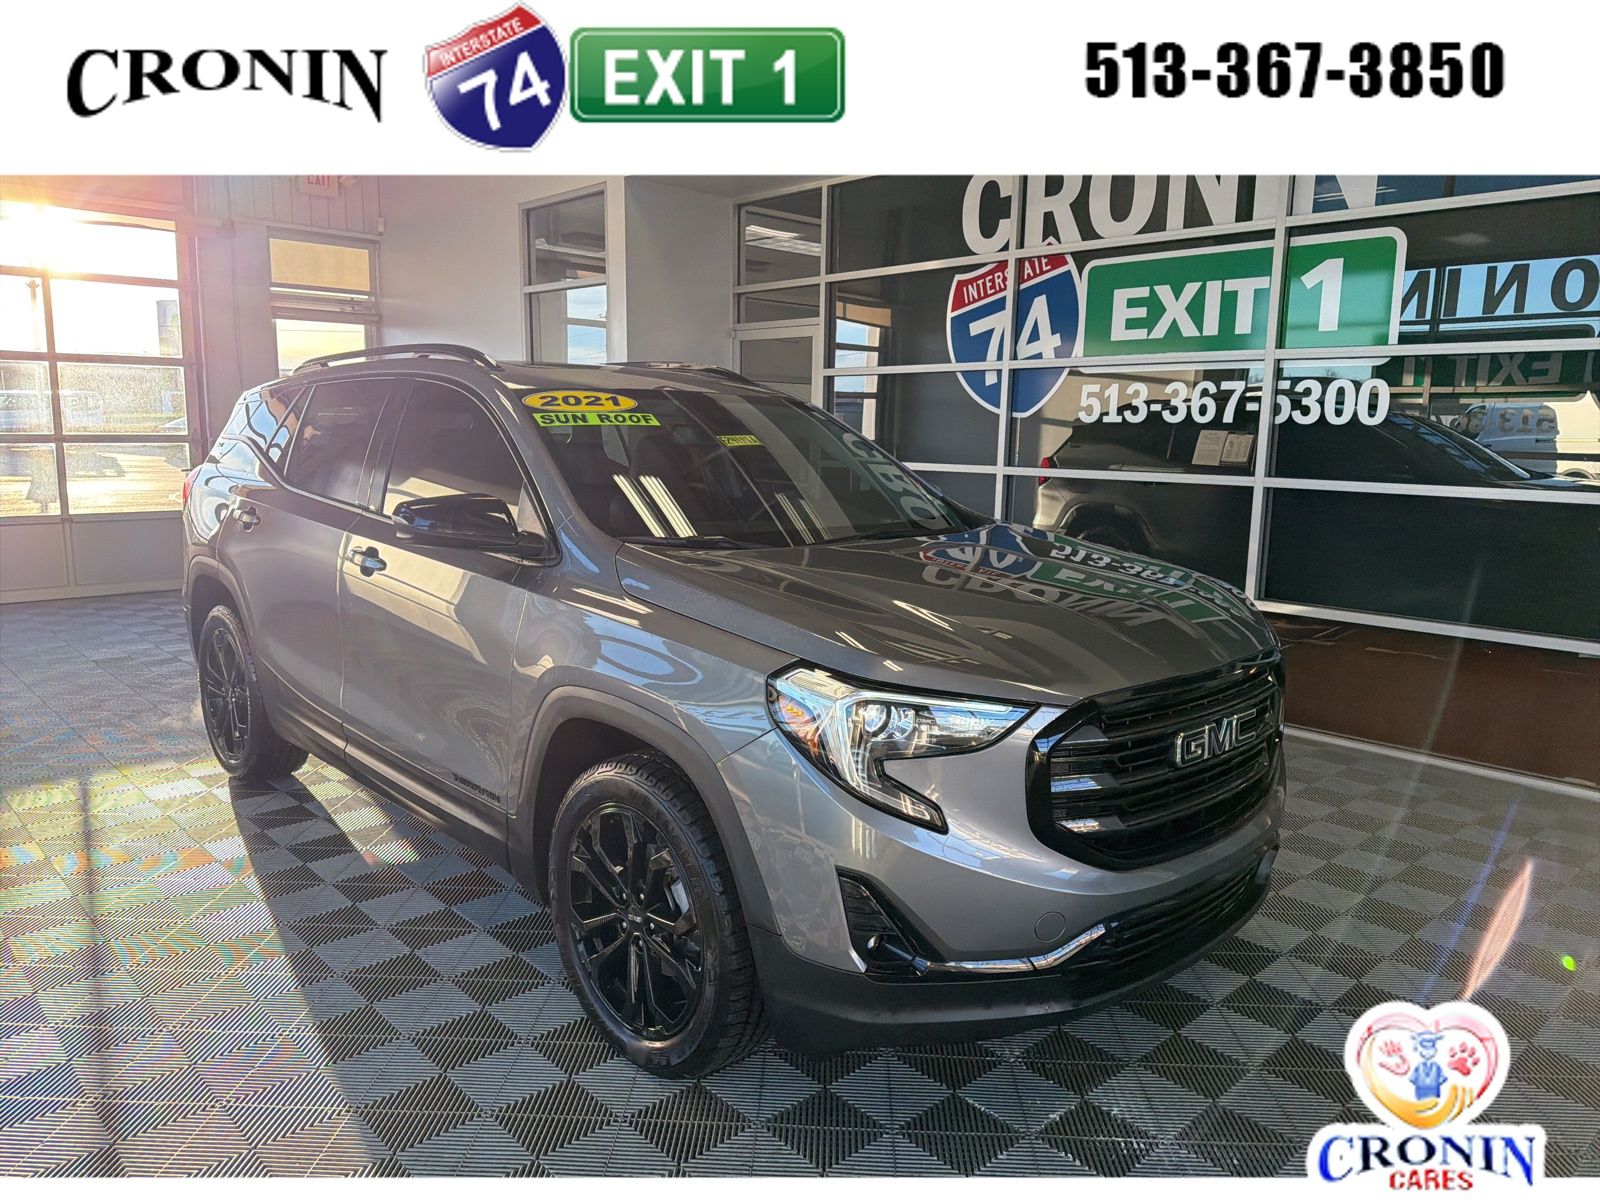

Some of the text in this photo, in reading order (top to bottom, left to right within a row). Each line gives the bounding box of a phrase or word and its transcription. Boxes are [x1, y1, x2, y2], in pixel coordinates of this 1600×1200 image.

[963, 256, 1052, 304] INTERATE
[1110, 257, 1345, 341] EXIT 1
[969, 294, 1062, 386] 74
[539, 395, 621, 407] 2021
[540, 413, 655, 424] SUN ROOF
[1174, 708, 1257, 768] GMC
